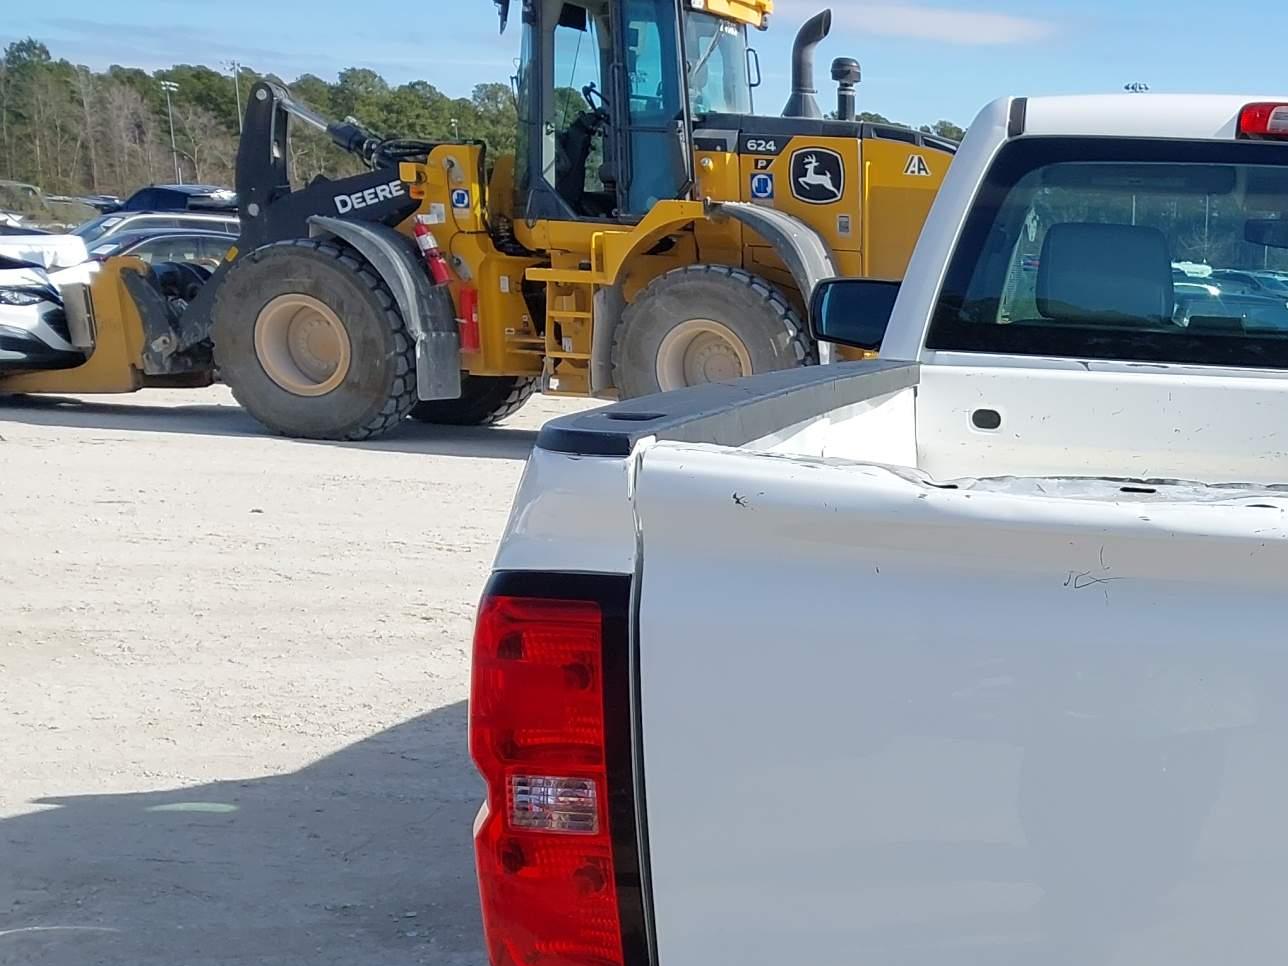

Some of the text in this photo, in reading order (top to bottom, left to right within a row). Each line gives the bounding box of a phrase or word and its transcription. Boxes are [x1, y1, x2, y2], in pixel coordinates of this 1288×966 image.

[746, 140, 777, 151] 624
[757, 160, 767, 169] P
[334, 180, 405, 214] DEERE
